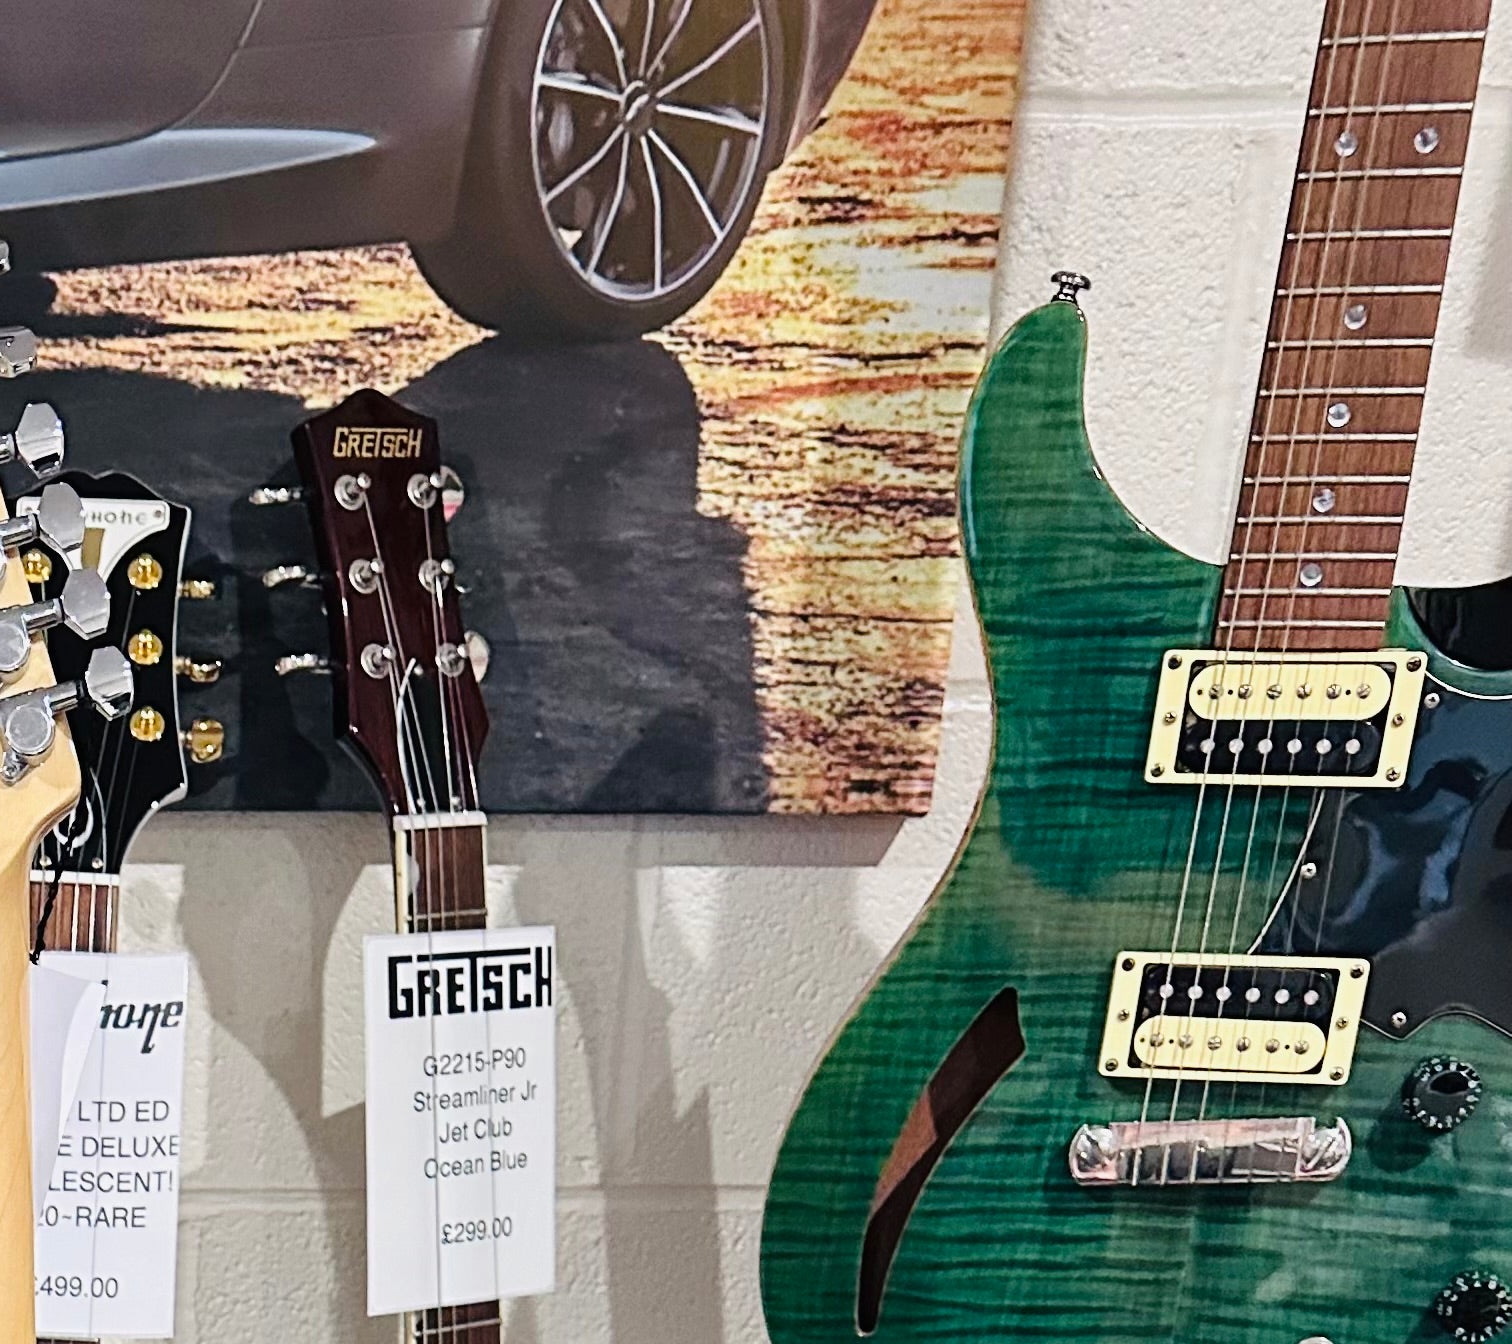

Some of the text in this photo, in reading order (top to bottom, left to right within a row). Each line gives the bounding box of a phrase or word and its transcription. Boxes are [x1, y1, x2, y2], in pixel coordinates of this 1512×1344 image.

[332, 427, 423, 458] GRETSCH
[388, 946, 552, 1019] GRETSCH
[423, 1047, 526, 1077] G2215-P90
[413, 1080, 537, 1113] Streamliner Jr
[78, 1100, 170, 1122] LTD ED
[439, 1117, 512, 1144] Jet Club
[82, 1135, 179, 1158] DELUXE
[423, 1151, 527, 1179] Ocean Blue
[48, 1170, 173, 1193] LESCENT!
[441, 1216, 512, 1245] £299.00
